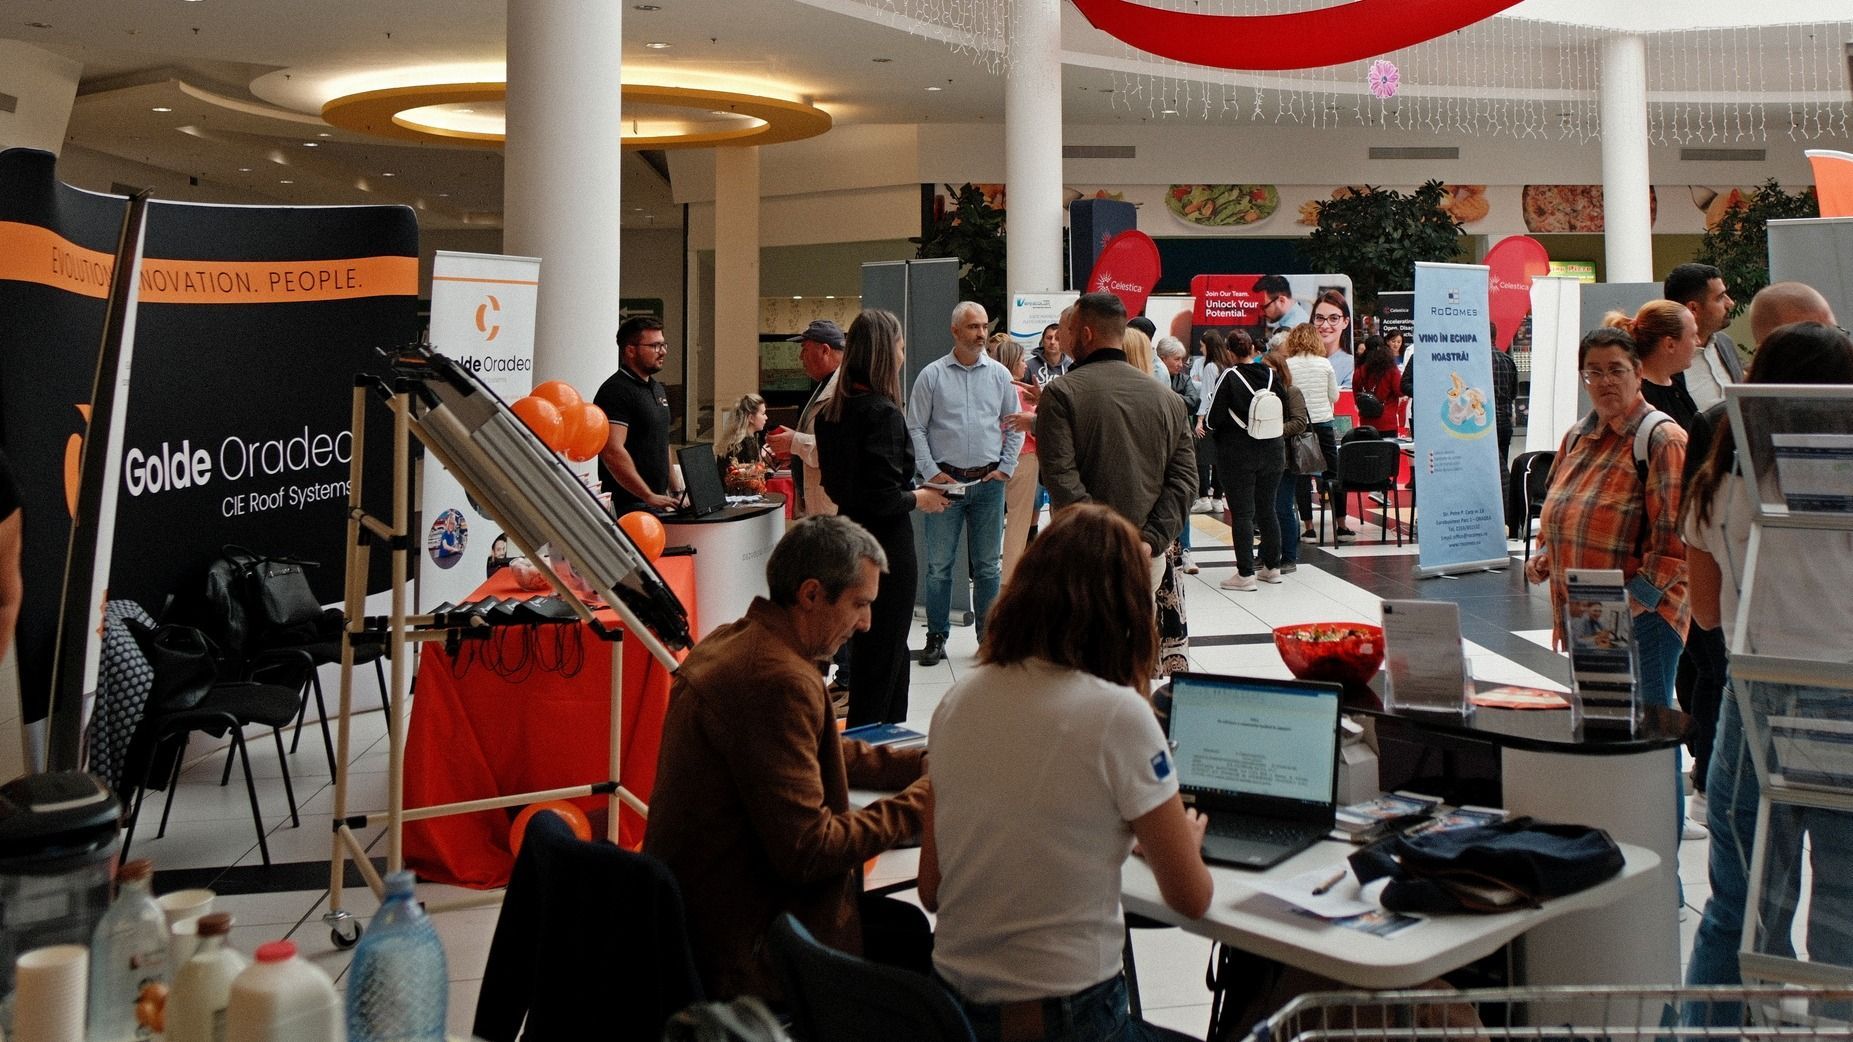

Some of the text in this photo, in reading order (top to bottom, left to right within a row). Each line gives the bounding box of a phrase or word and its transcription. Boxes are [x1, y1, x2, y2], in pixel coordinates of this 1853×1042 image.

[139, 269, 258, 293] NOVATION.
[269, 268, 362, 293] PEOPLE.
[1500, 281, 1529, 291] Celestica
[1111, 281, 1142, 293] Celestica
[1206, 300, 1258, 308] Unlock Your
[1206, 309, 1247, 317] Potential.
[1419, 333, 1438, 343] VINO
[1450, 334, 1478, 343] ECHIPA
[460, 355, 531, 372] lde Oradea
[125, 439, 212, 497] Golde
[222, 494, 246, 517] CIE
[250, 486, 285, 513] Roof
